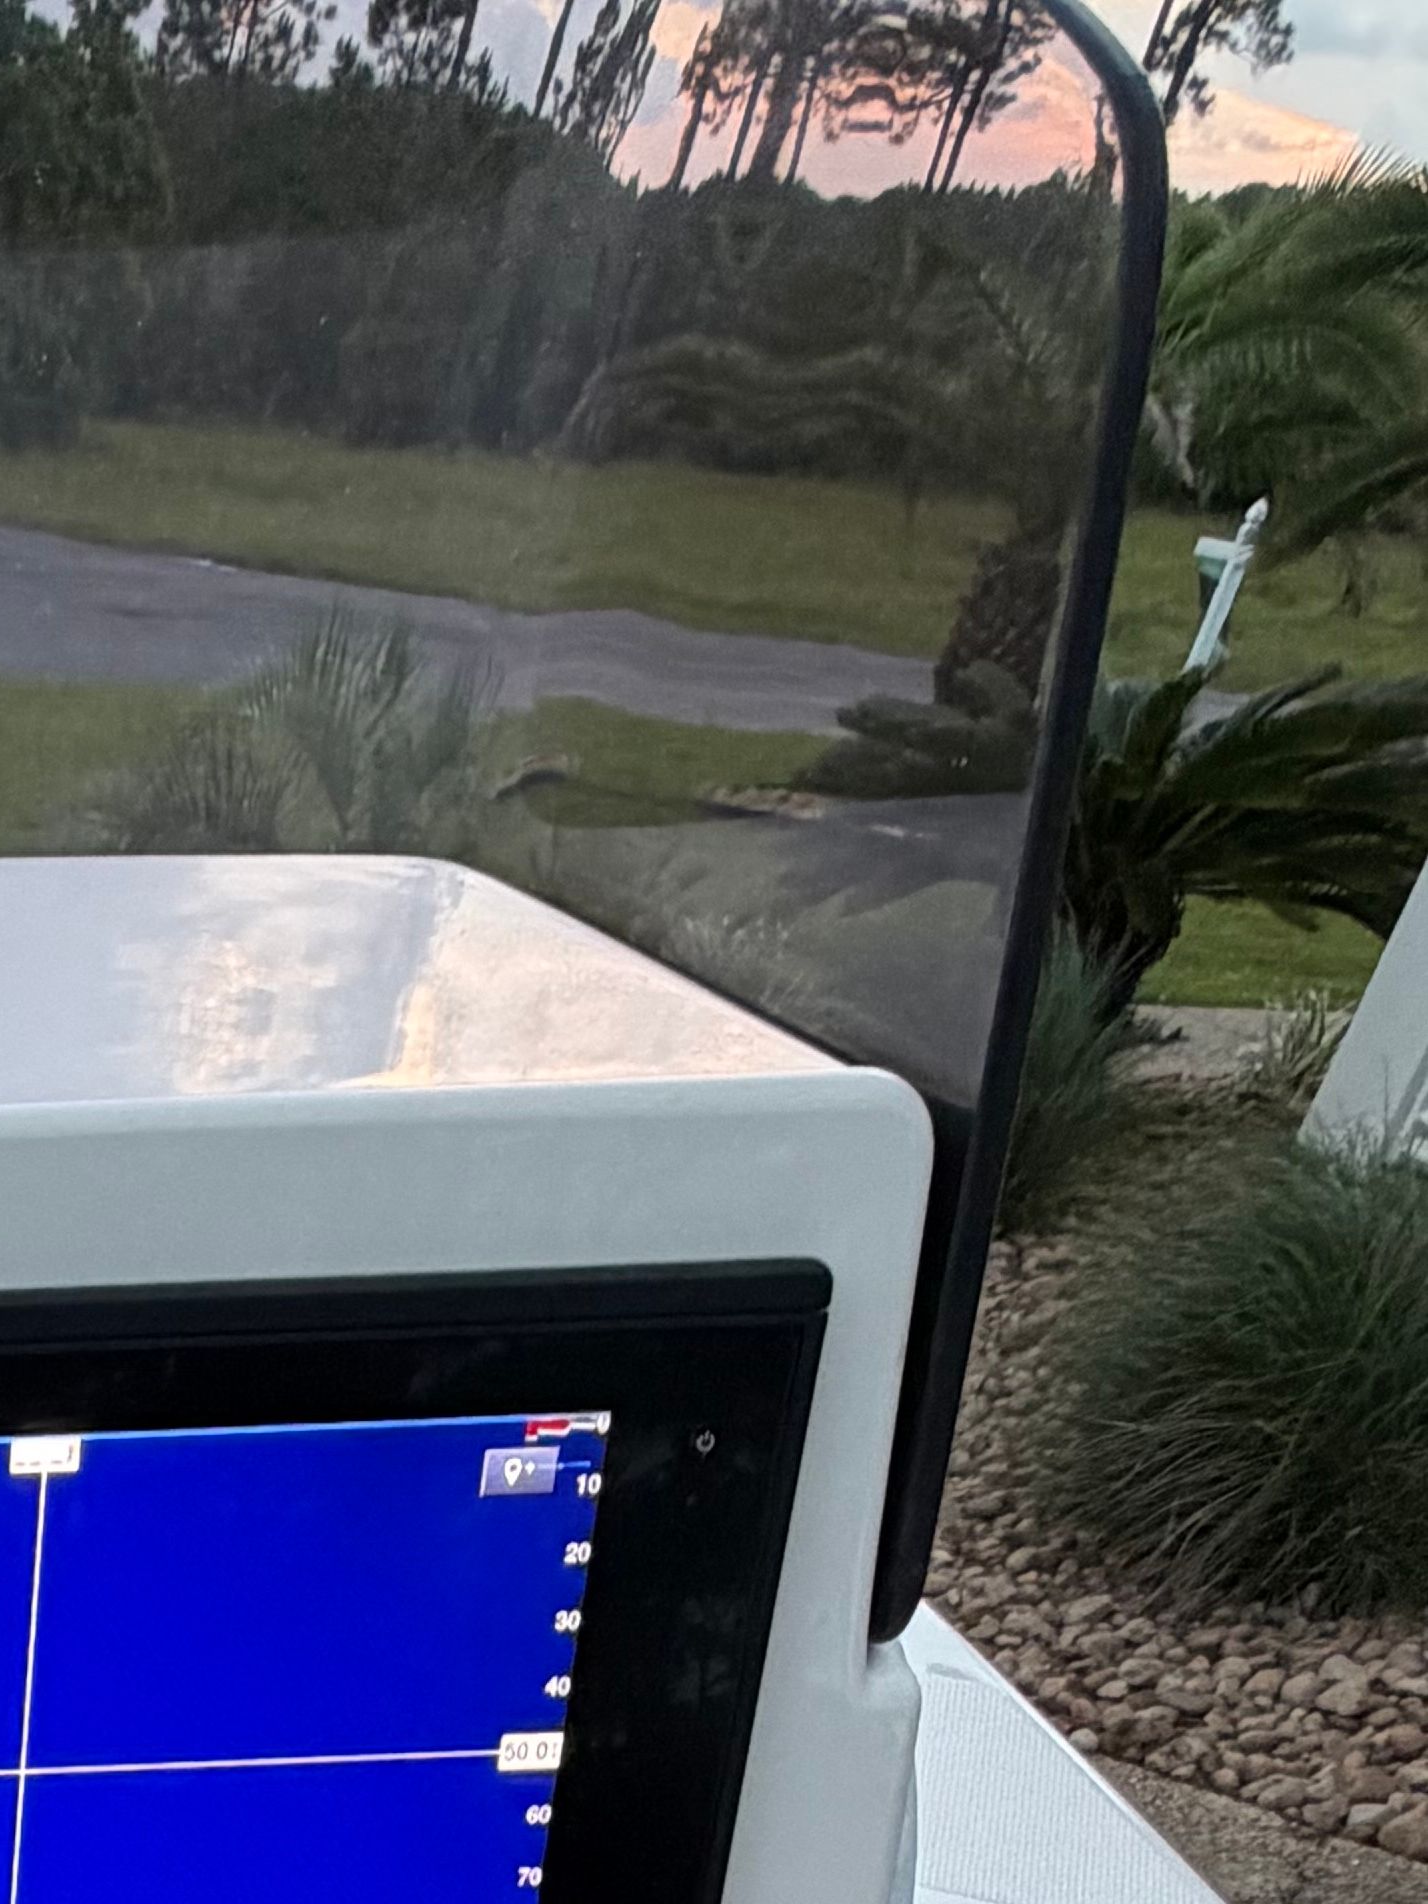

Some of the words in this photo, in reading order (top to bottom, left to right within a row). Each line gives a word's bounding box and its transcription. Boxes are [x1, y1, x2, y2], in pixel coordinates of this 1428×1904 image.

[577, 1473, 602, 1495] 10
[564, 1541, 591, 1564] 20
[554, 1610, 582, 1632] 30
[544, 1674, 571, 1697] 40
[525, 1804, 552, 1825] 60
[517, 1866, 542, 1887] 70
